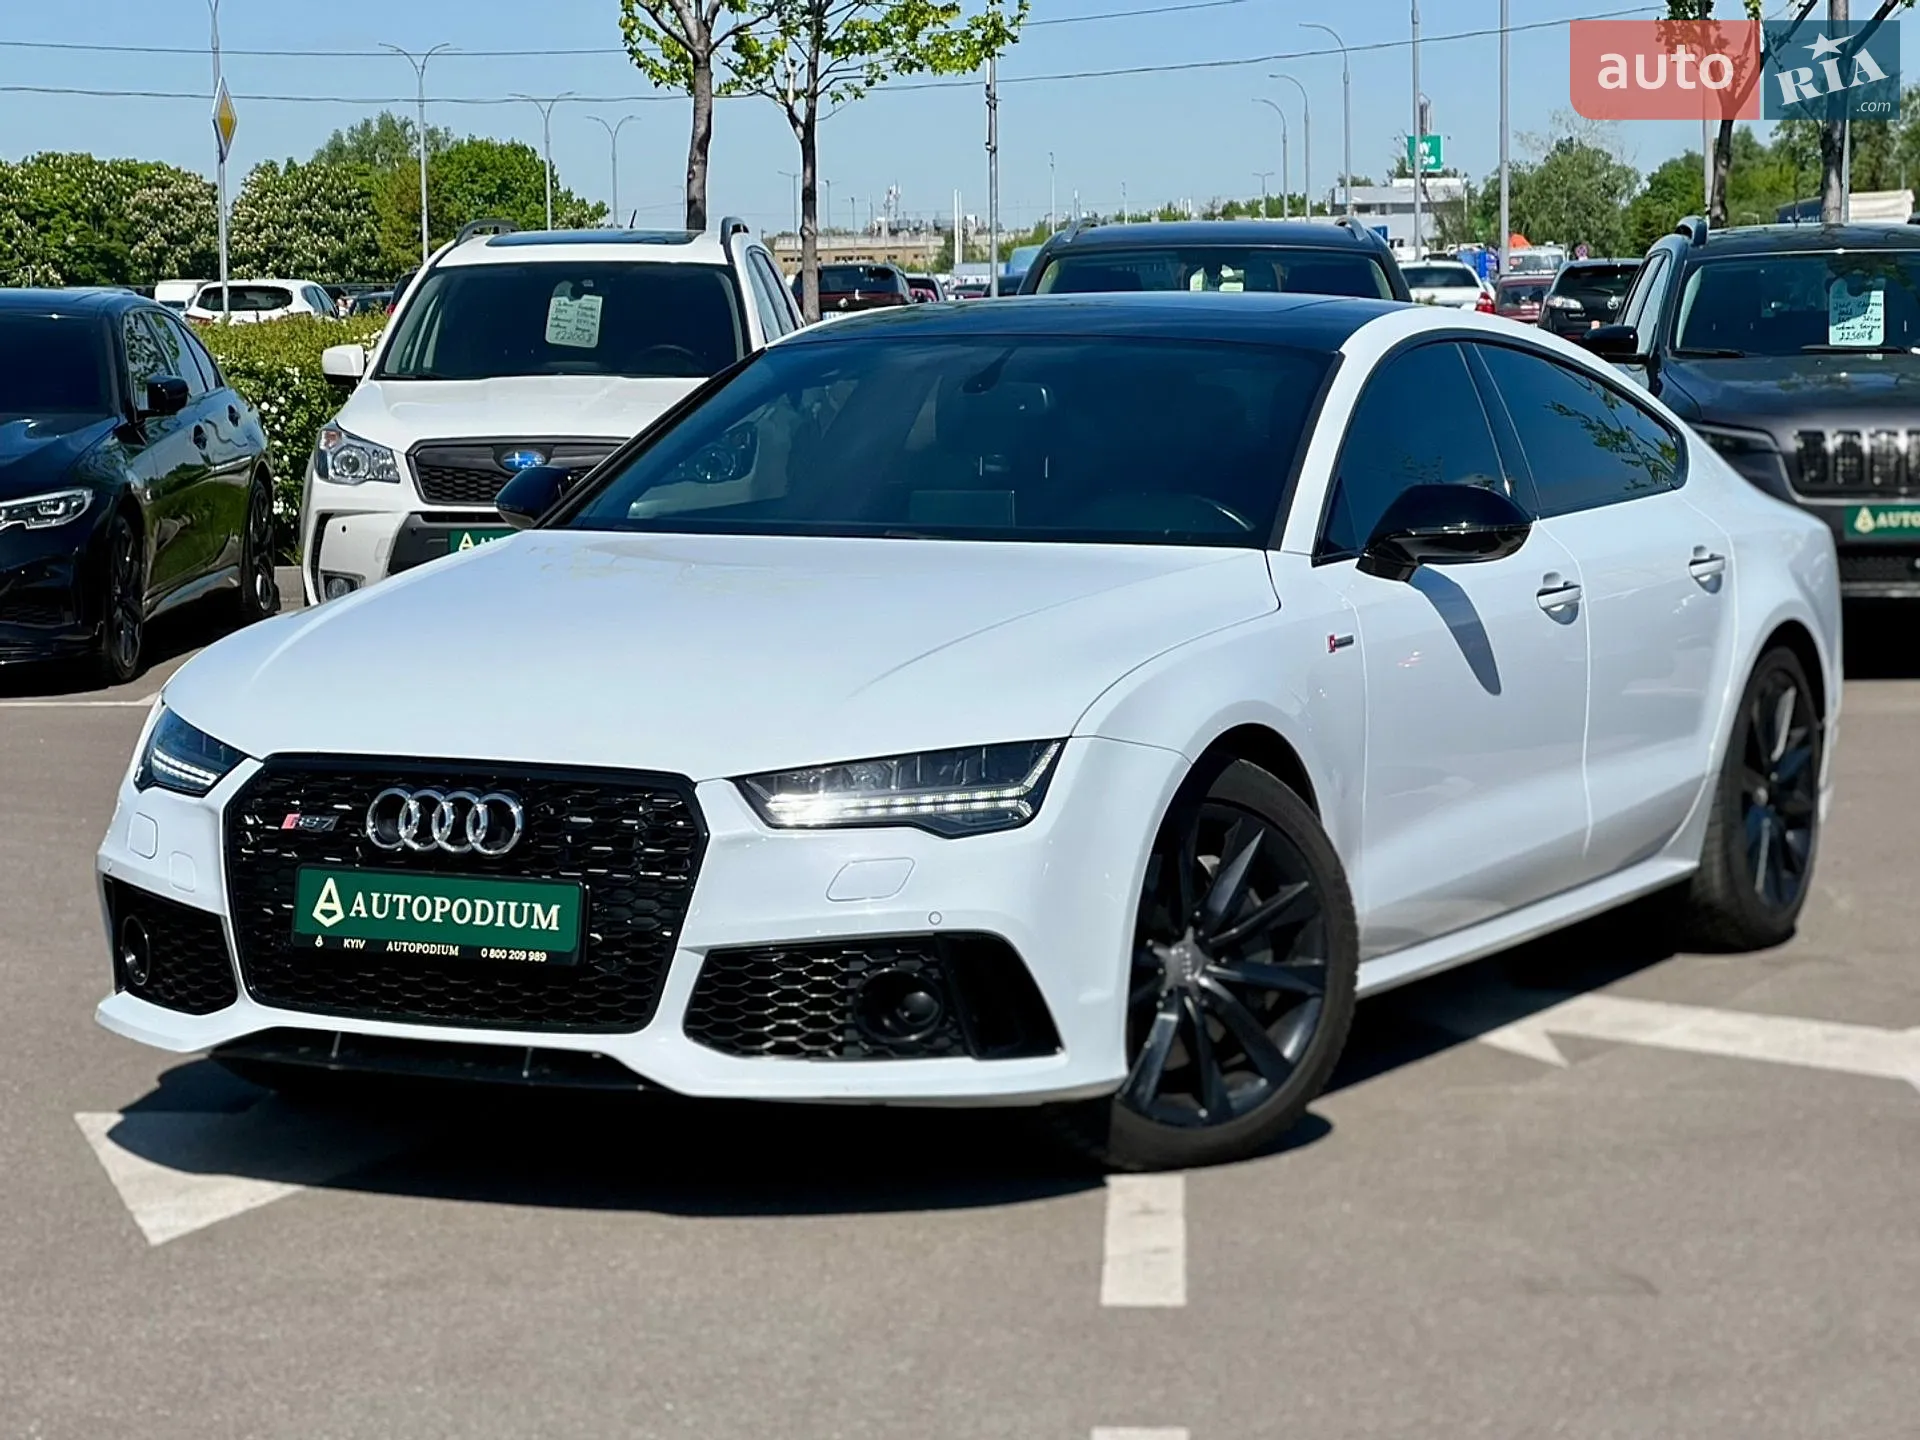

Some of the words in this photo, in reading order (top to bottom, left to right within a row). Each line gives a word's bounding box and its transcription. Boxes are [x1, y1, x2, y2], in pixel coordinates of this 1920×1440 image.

[349, 891, 561, 931] AUTOPODIUM
[343, 937, 366, 949] KYIV
[386, 940, 459, 956] AUTOPODIUM
[489, 948, 507, 960] 800
[509, 950, 527, 961] 209
[529, 951, 547, 962] 989
